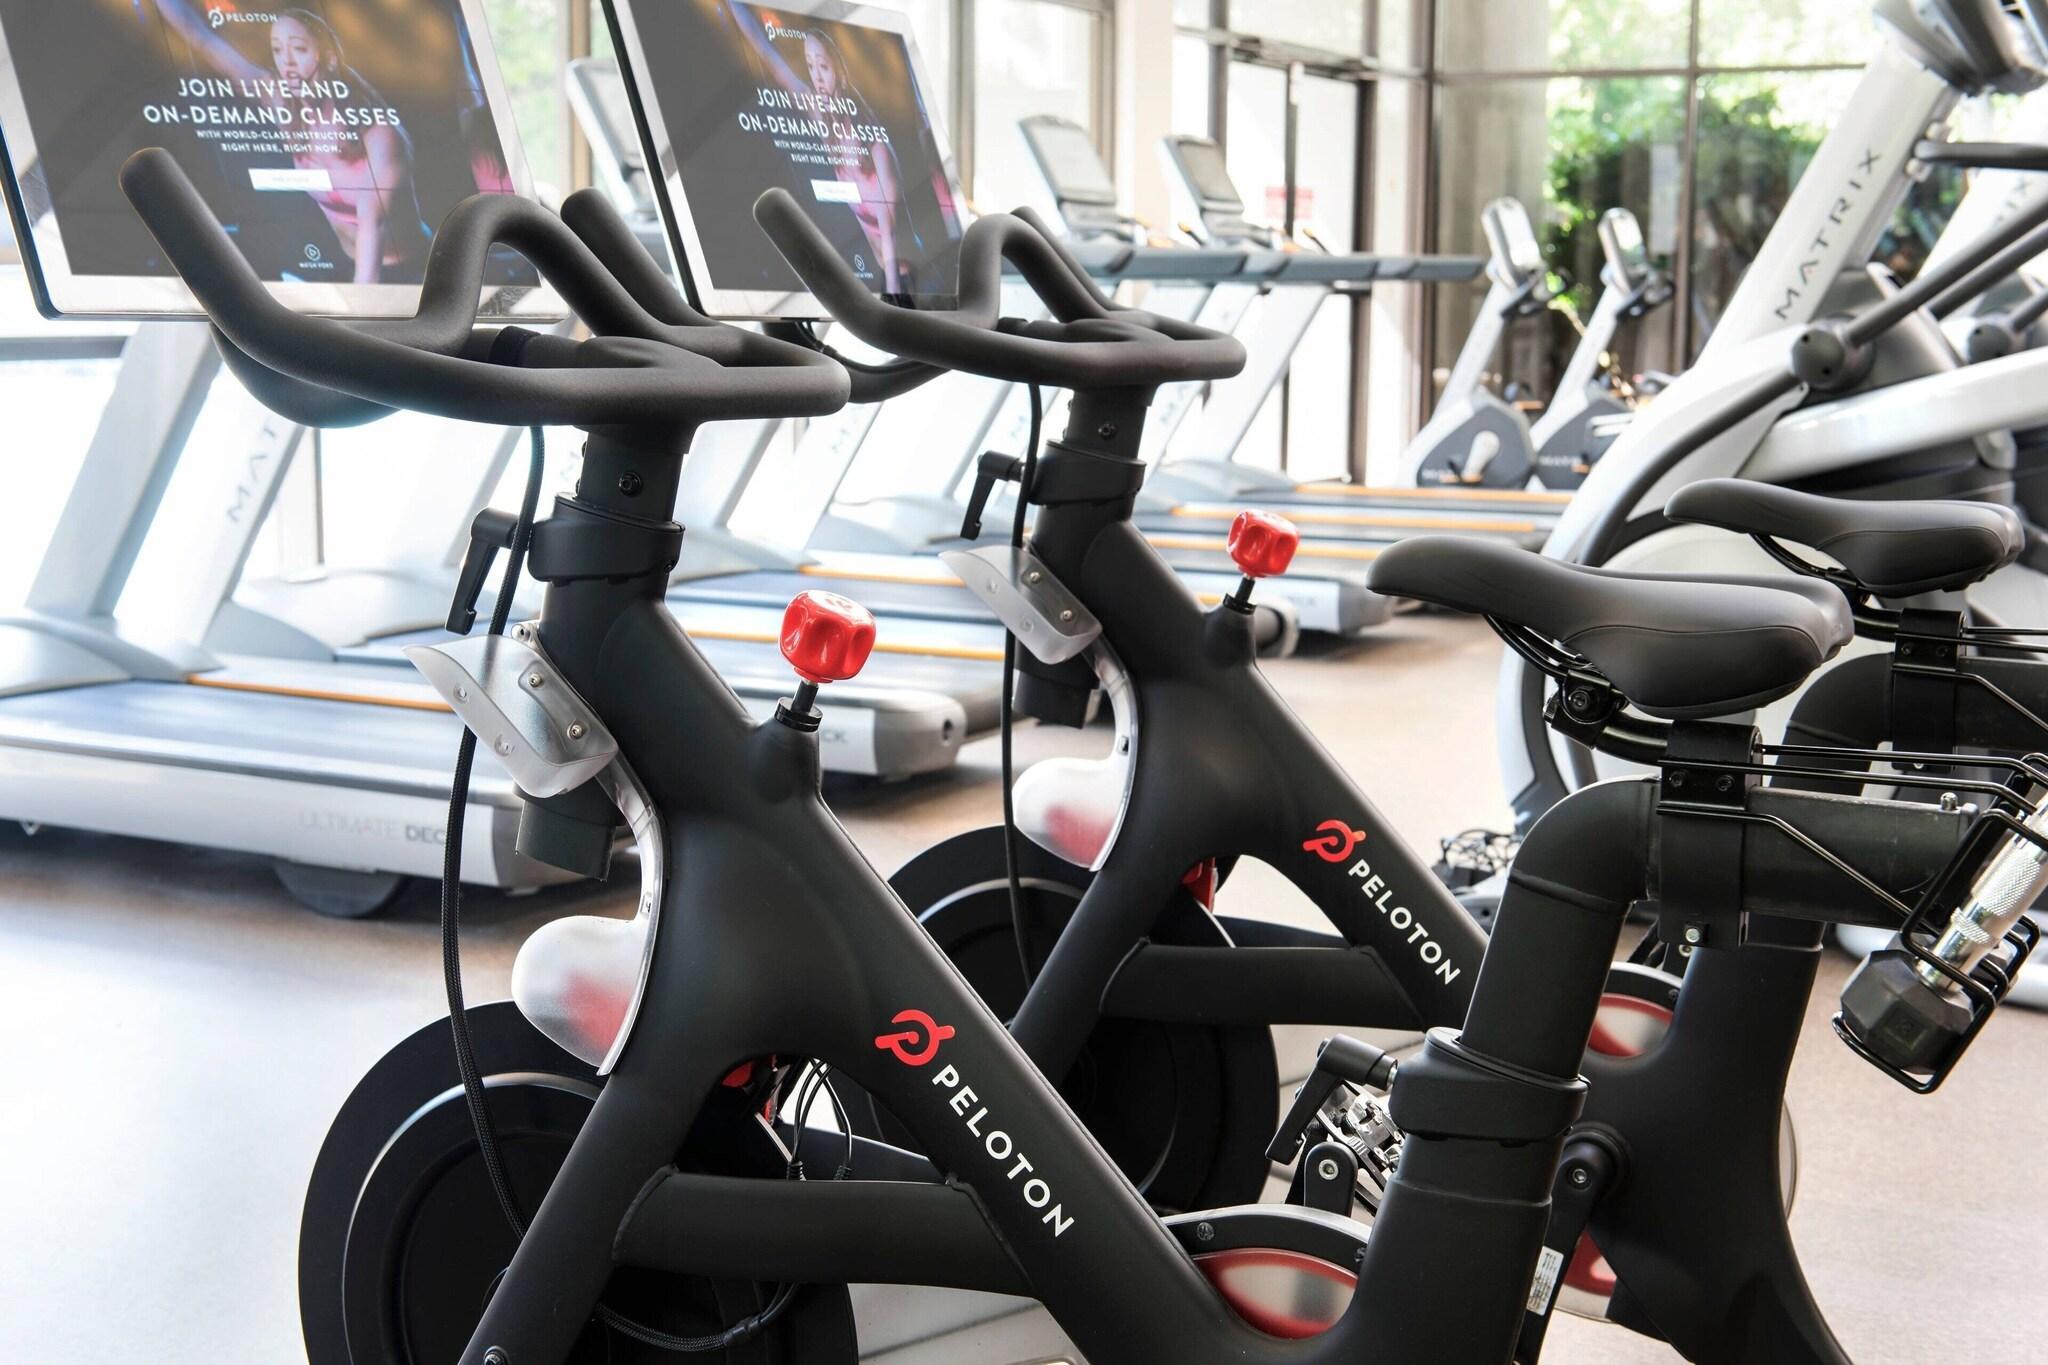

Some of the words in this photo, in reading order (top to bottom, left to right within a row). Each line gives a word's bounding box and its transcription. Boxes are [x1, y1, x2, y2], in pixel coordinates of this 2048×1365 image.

[226, 13, 279, 23] PELOTON
[775, 27, 807, 40] PELOTON
[177, 78, 234, 98] JOIN
[241, 79, 292, 98] LIVE
[300, 80, 349, 99] AND
[757, 88, 792, 109] JOIN
[793, 92, 826, 113] LIVE
[829, 96, 858, 116] AND
[143, 105, 293, 125] ON-DEMAND
[300, 108, 400, 127] CLASSES
[195, 130, 222, 139] WITH
[223, 130, 291, 140] WORLD-CLASS
[292, 131, 359, 141] INSTRUCTORS
[738, 113, 829, 138] ON-DEMAND
[832, 123, 889, 143] CLASSES
[221, 143, 250, 153] RIGHT
[284, 144, 312, 153] RIGHT
[774, 140, 790, 149] WITH
[832, 145, 869, 155] INSTRUCTORS
[792, 154, 809, 164] RIGHT
[828, 156, 846, 166] RIGHT
[1773, 149, 1881, 320] MATRIX
[404, 823, 447, 845] DEC
[1347, 858, 1461, 985] PELOTON
[931, 1064, 1075, 1238] PELOTON
